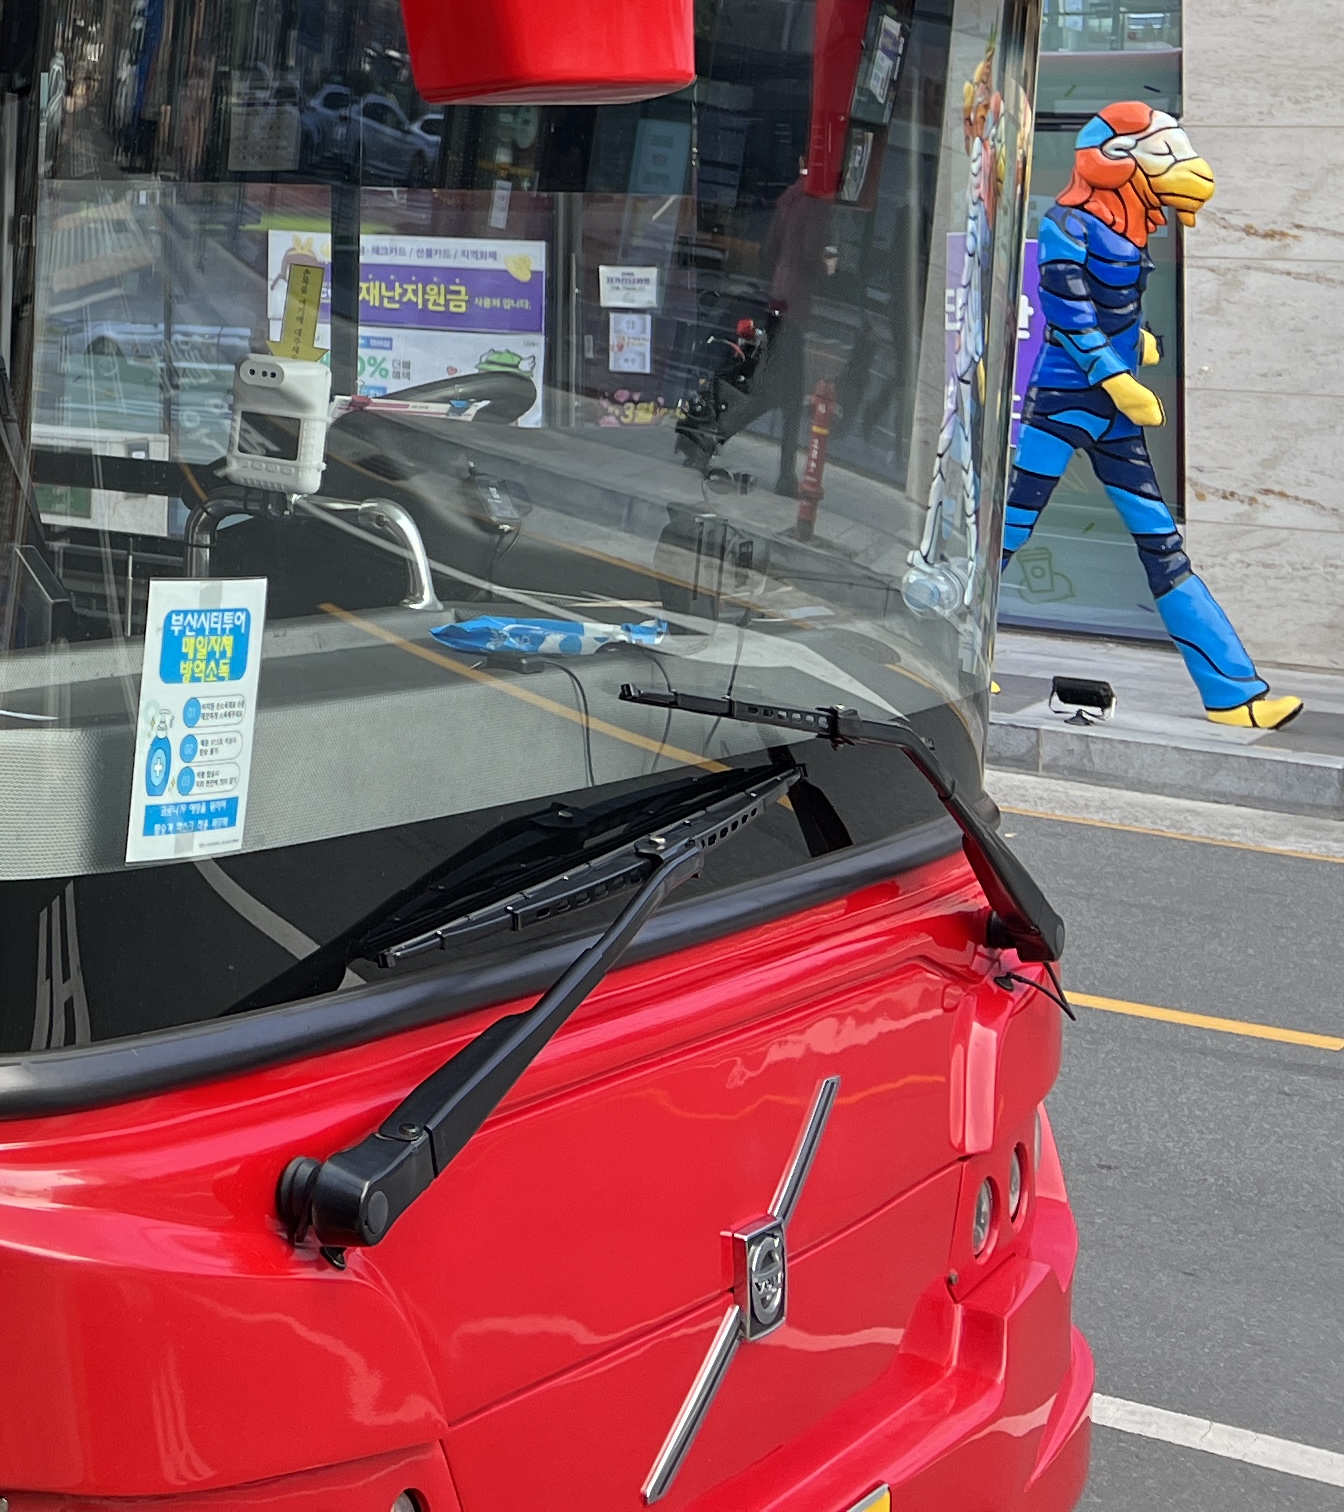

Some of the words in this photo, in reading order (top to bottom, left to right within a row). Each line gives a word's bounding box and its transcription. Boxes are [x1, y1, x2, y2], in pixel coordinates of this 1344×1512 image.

[359, 280, 470, 314] 재난지원금
[170, 610, 247, 637] 부산시티투어
[181, 635, 234, 659] 매일자체
[180, 659, 231, 684] 방역소독
